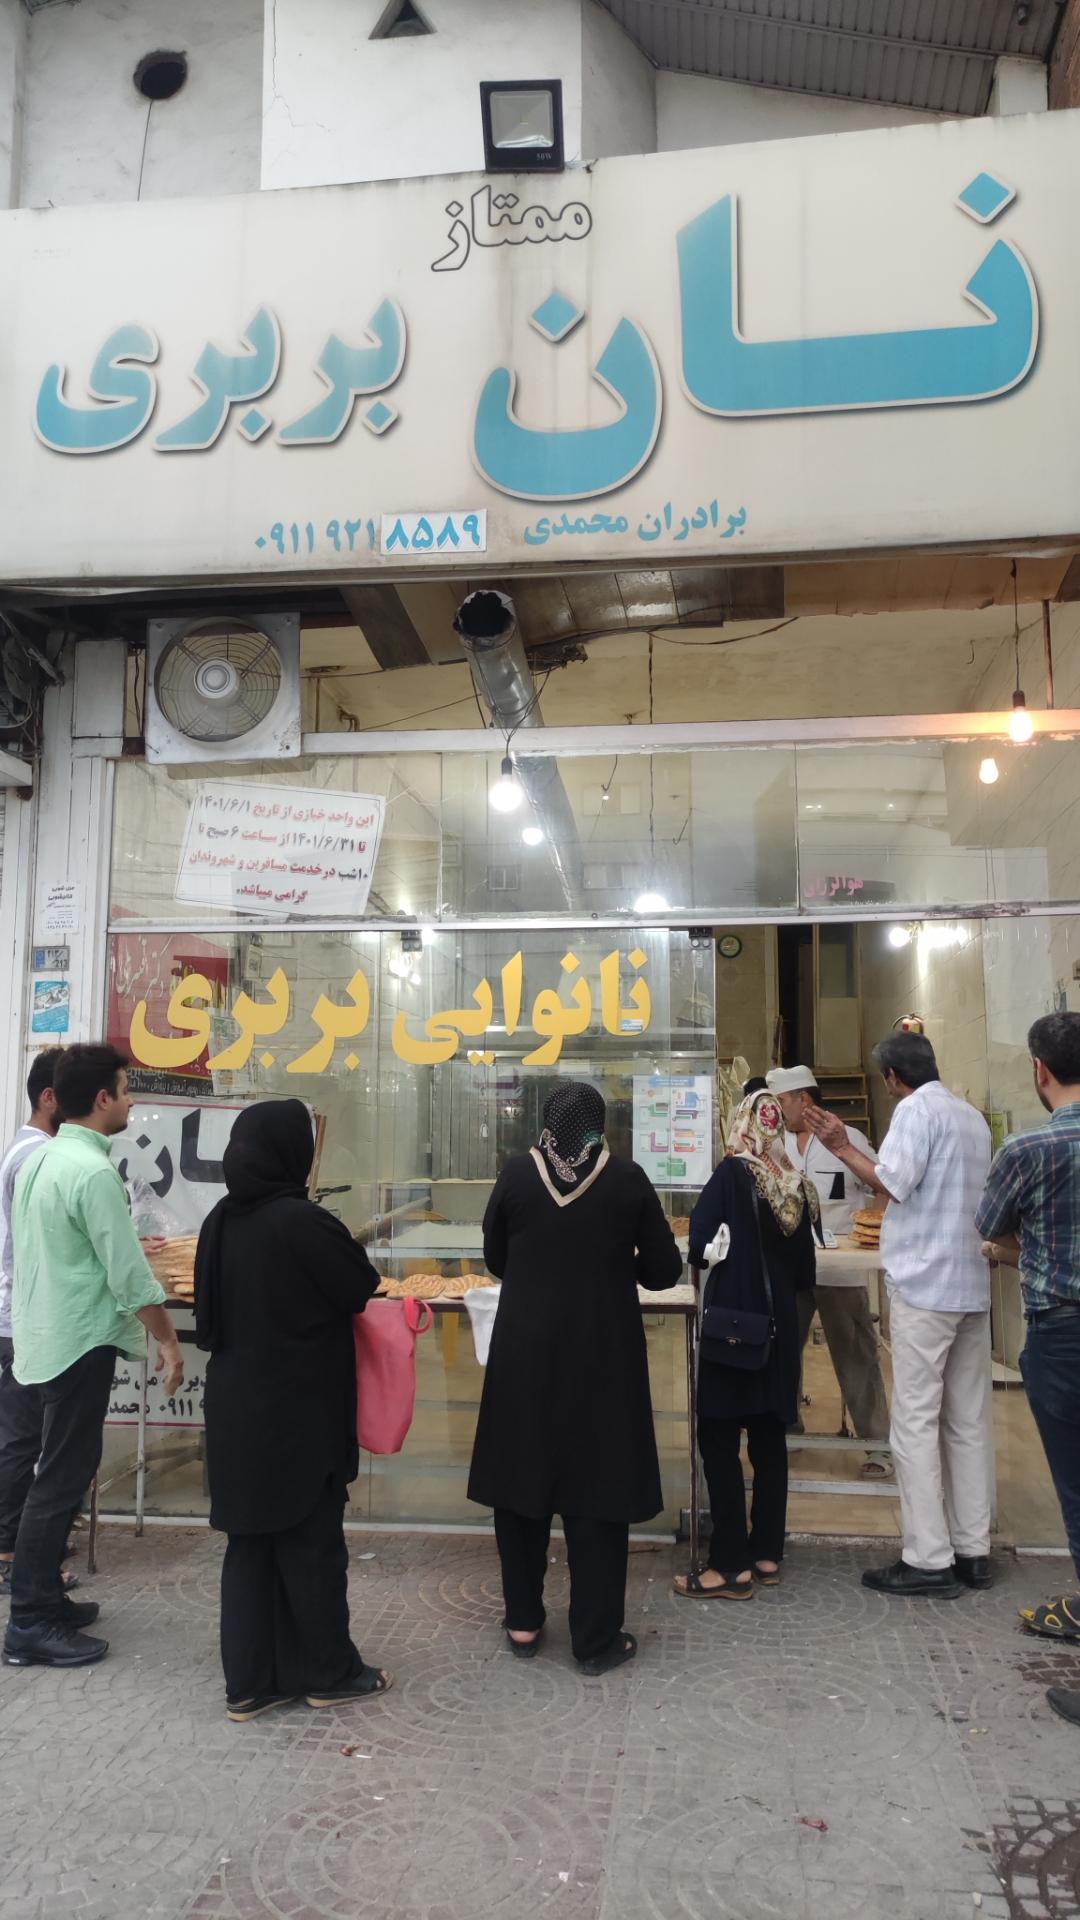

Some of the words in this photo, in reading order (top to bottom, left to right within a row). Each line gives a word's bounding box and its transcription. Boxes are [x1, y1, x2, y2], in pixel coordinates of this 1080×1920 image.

[431, 185, 593, 272] ممتاز
[473, 169, 1041, 502] نان
[34, 295, 408, 455] بربری
[637, 499, 747, 541] برادران
[254, 521, 315, 554] ۰۹۱۱
[326, 518, 376, 551] ۹۲۱
[386, 514, 481, 550] ۸۵۸۹
[523, 512, 629, 546] محمدی
[199, 795, 250, 812] ۱۴۰۱/۶/۱
[253, 803, 280, 818] تاریخ
[280, 805, 293, 820] از
[293, 808, 326, 823] خبازی
[328, 811, 354, 827] واحد
[198, 822, 205, 835] تا
[355, 814, 374, 828] این
[206, 826, 229, 839] صبح
[241, 829, 277, 842] ساعت
[280, 832, 291, 847] از
[293, 832, 355, 852] ۱۴۰۱/۶/۳۱
[358, 841, 367, 853] تا
[189, 850, 235, 866] شهروندان
[236, 859, 243, 871] و
[247, 857, 288, 873] مسافرین
[290, 863, 322, 875] خدمت
[321, 867, 336, 880] در
[275, 889, 308, 904] گرامی
[391, 947, 651, 1066] نانوایی
[129, 966, 371, 1073] بربری
